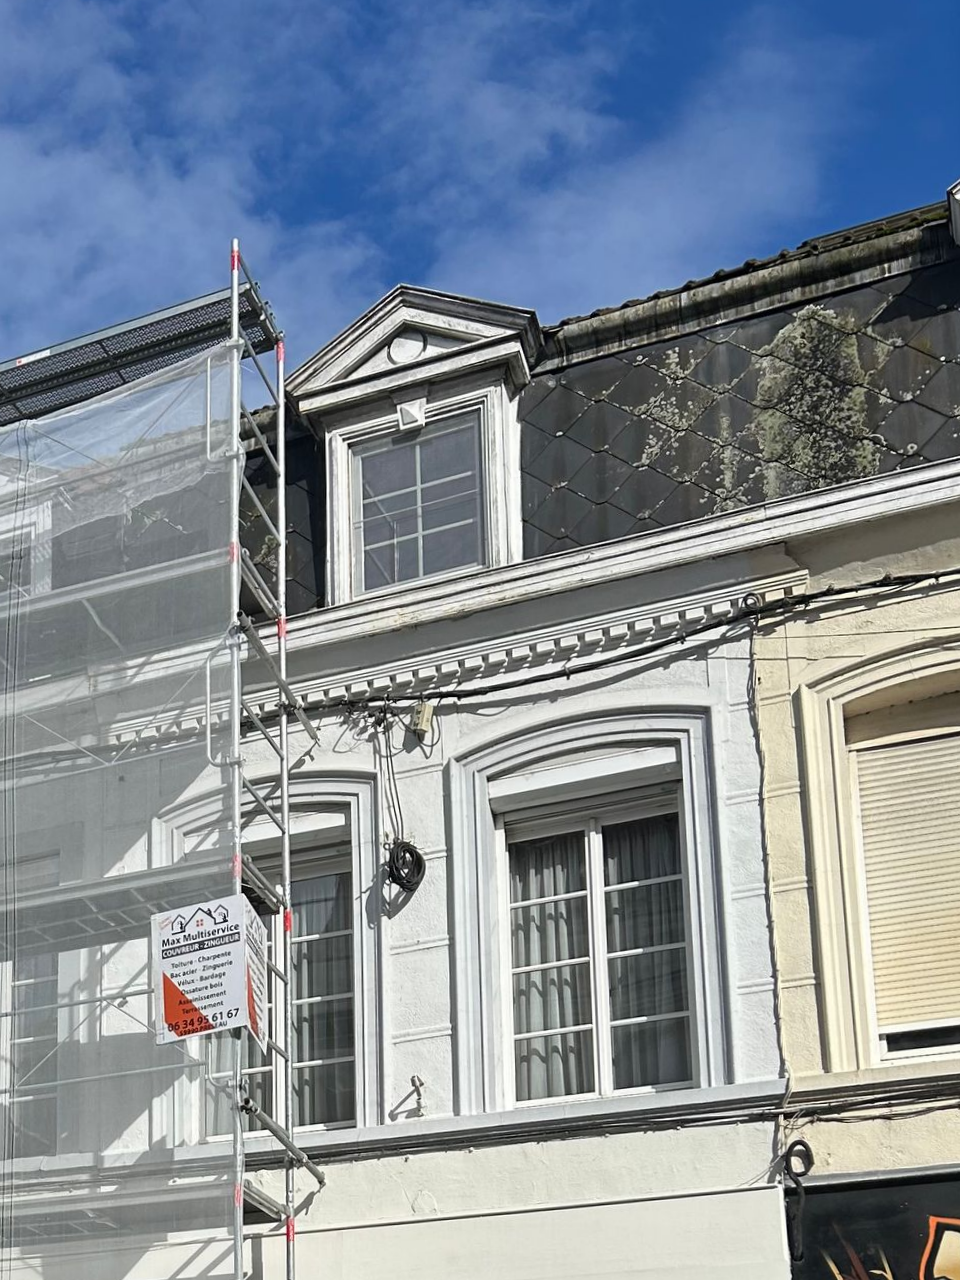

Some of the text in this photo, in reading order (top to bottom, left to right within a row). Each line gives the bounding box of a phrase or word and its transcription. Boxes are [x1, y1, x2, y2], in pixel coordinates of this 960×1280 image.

[162, 937, 181, 947] Max
[183, 923, 239, 942] Multiservice
[163, 943, 200, 958] COUVREUR
[204, 934, 239, 949] ZINGUEUR
[171, 960, 193, 969] Toiture
[198, 951, 231, 963] Charpente
[202, 960, 233, 972] Zinguerie
[200, 970, 226, 983] Bardage
[181, 982, 223, 995] Ossature bois
[168, 1009, 239, 1031] 06 34 95 61 67
